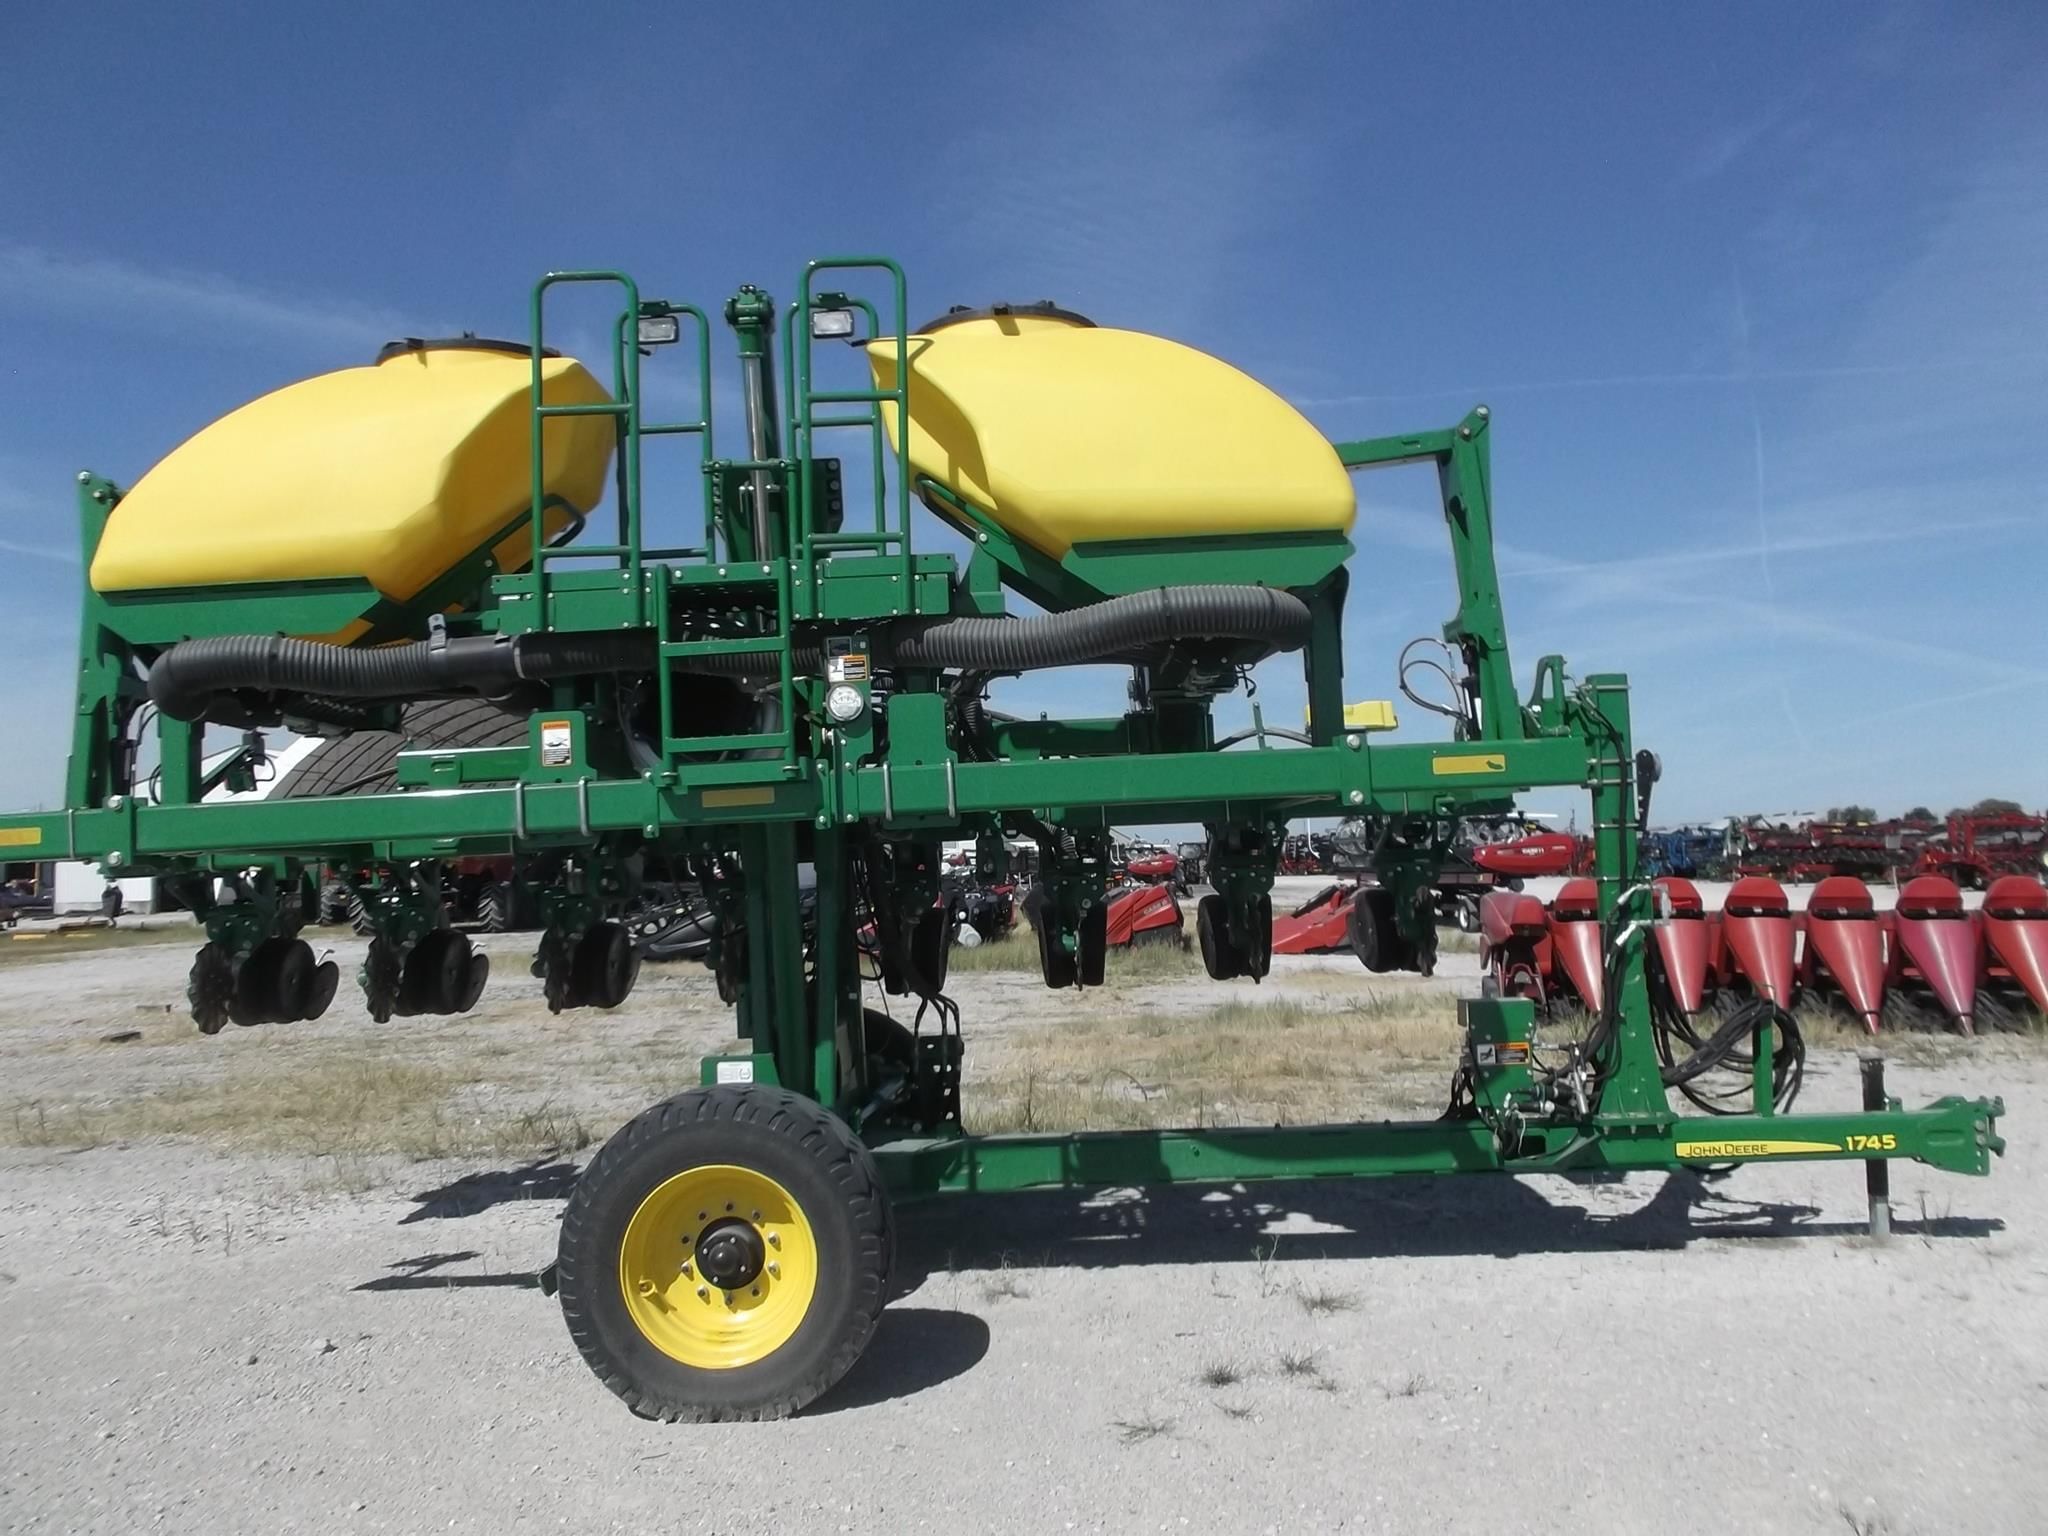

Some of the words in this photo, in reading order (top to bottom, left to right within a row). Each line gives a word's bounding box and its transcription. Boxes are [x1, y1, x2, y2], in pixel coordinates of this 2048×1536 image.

[1686, 1144, 1722, 1156] JOHN
[1724, 1143, 1768, 1154] DEERE
[1846, 1134, 1896, 1151] 1745
